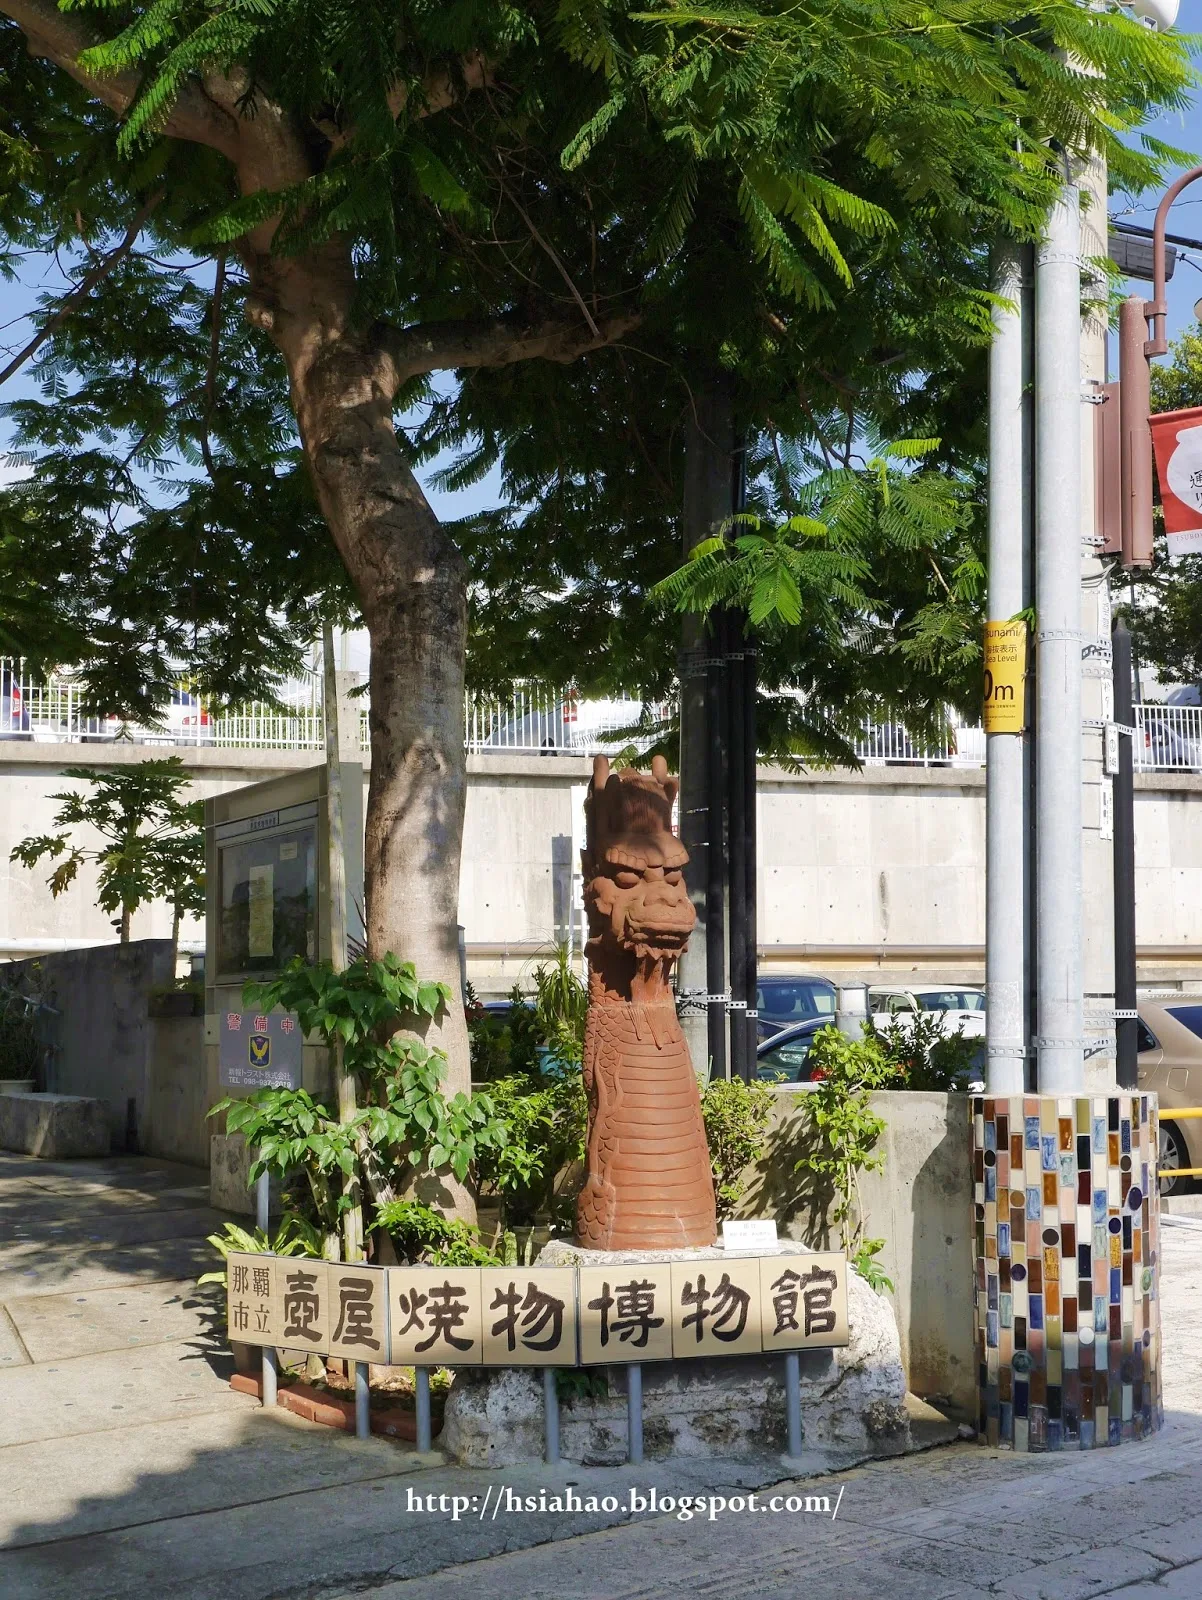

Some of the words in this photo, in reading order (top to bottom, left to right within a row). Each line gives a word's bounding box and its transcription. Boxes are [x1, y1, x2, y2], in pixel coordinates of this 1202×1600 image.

[998, 654, 1017, 662] Level
[227, 1013, 294, 1034] 警備中
[228, 1076, 240, 1084] TEL
[233, 1265, 269, 1297] 那覇
[233, 1301, 271, 1333] 市立
